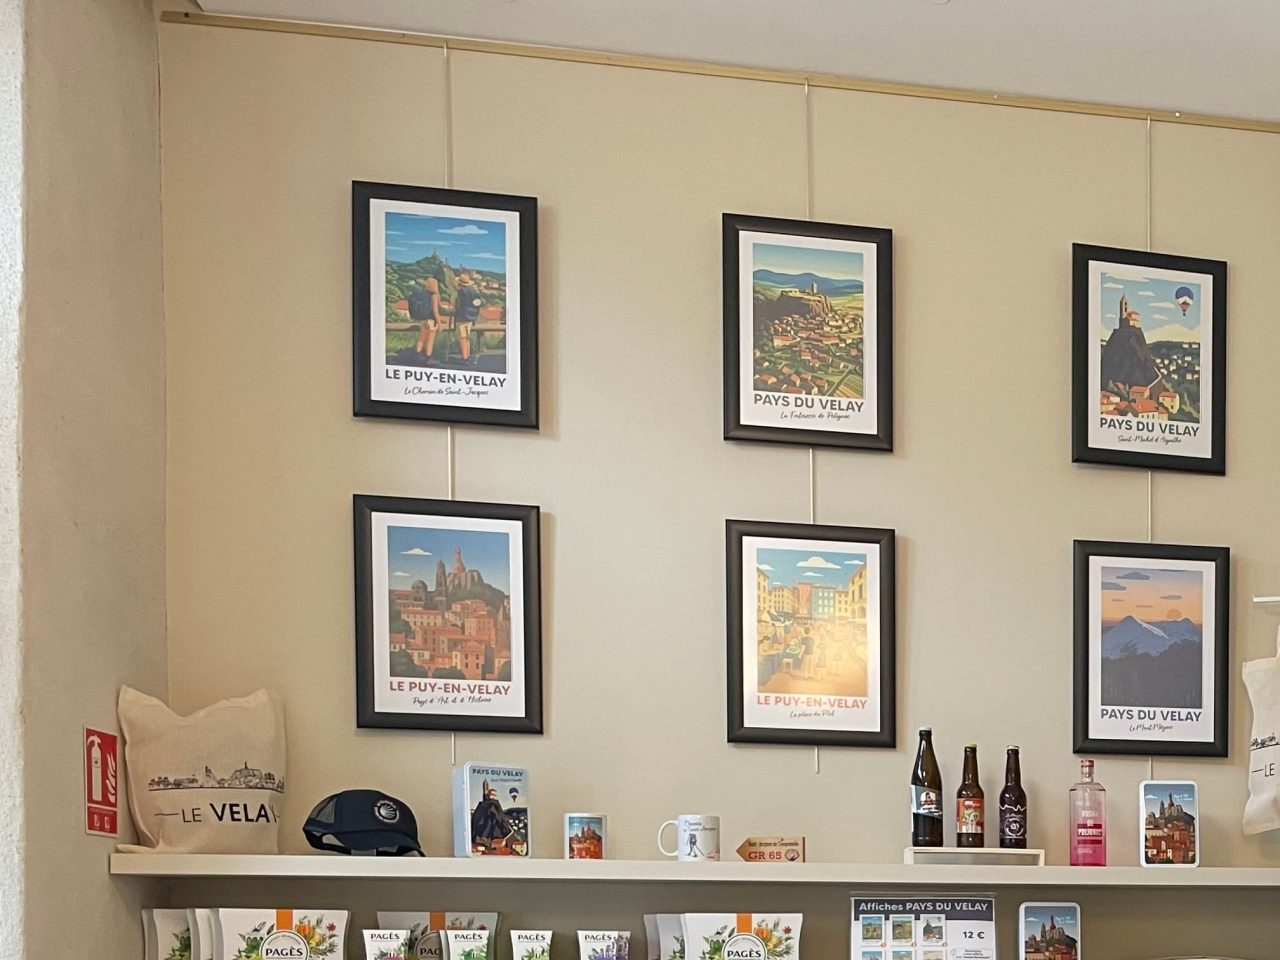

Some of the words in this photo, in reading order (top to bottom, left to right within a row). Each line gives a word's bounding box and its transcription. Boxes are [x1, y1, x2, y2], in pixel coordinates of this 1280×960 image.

[386, 368, 400, 380] LE
[405, 370, 506, 388] PUY-EN-VELAY
[754, 394, 790, 407] PAYS
[794, 397, 815, 408] DU
[819, 398, 865, 413] VELAY
[1100, 417, 1132, 430] PAYS
[1137, 421, 1155, 433] DU
[1159, 423, 1200, 437] VELAY
[390, 681, 404, 691] LE
[409, 682, 511, 695] PUY-EN-VELAY
[757, 695, 771, 705] LE
[775, 696, 867, 709] PUY-EN-VELAY
[1101, 708, 1134, 720] PAYS
[1138, 710, 1156, 720] DU
[1161, 710, 1202, 722] VELAY
[1264, 763, 1275, 777] LE
[182, 808, 202, 823] LE
[748, 851, 766, 859] GR
[769, 851, 782, 859] 65
[859, 902, 903, 911] Affiches
[905, 902, 933, 911] PAYS
[954, 902, 988, 911] VELAY
[370, 931, 400, 940] PAGÈS
[454, 932, 483, 940] PAGÈS
[518, 933, 546, 941] PAGÈS
[584, 933, 612, 941] PAGÈS
[963, 931, 974, 939] 12
[977, 931, 985, 939] €
[266, 946, 303, 956] PAGÈS
[420, 947, 440, 956] PAG
[727, 947, 761, 958] PAGÈS
